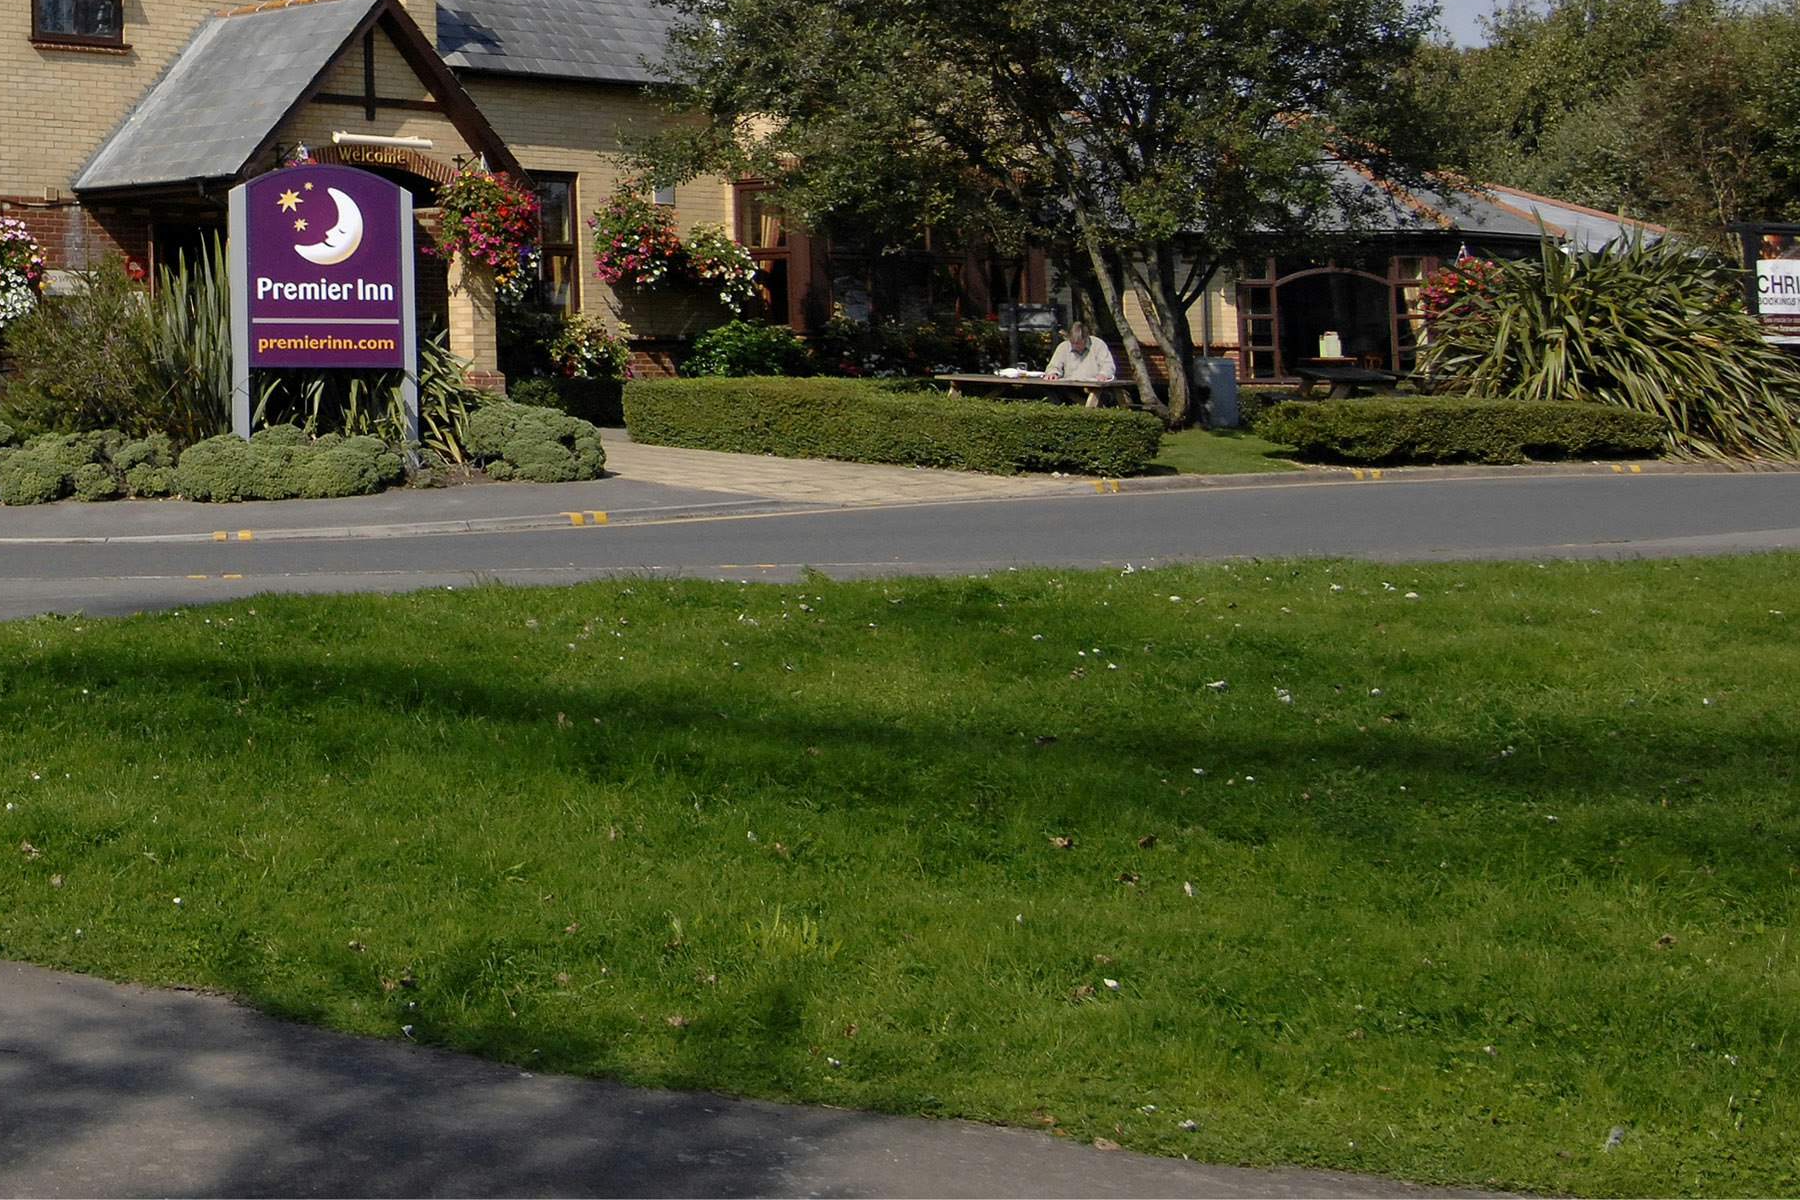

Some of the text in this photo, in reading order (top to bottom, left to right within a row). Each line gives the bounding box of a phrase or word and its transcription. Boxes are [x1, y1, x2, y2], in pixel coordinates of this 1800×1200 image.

[338, 145, 406, 165] Welcome
[256, 277, 394, 301] Premier Inn
[258, 335, 395, 353] premierinn.com
